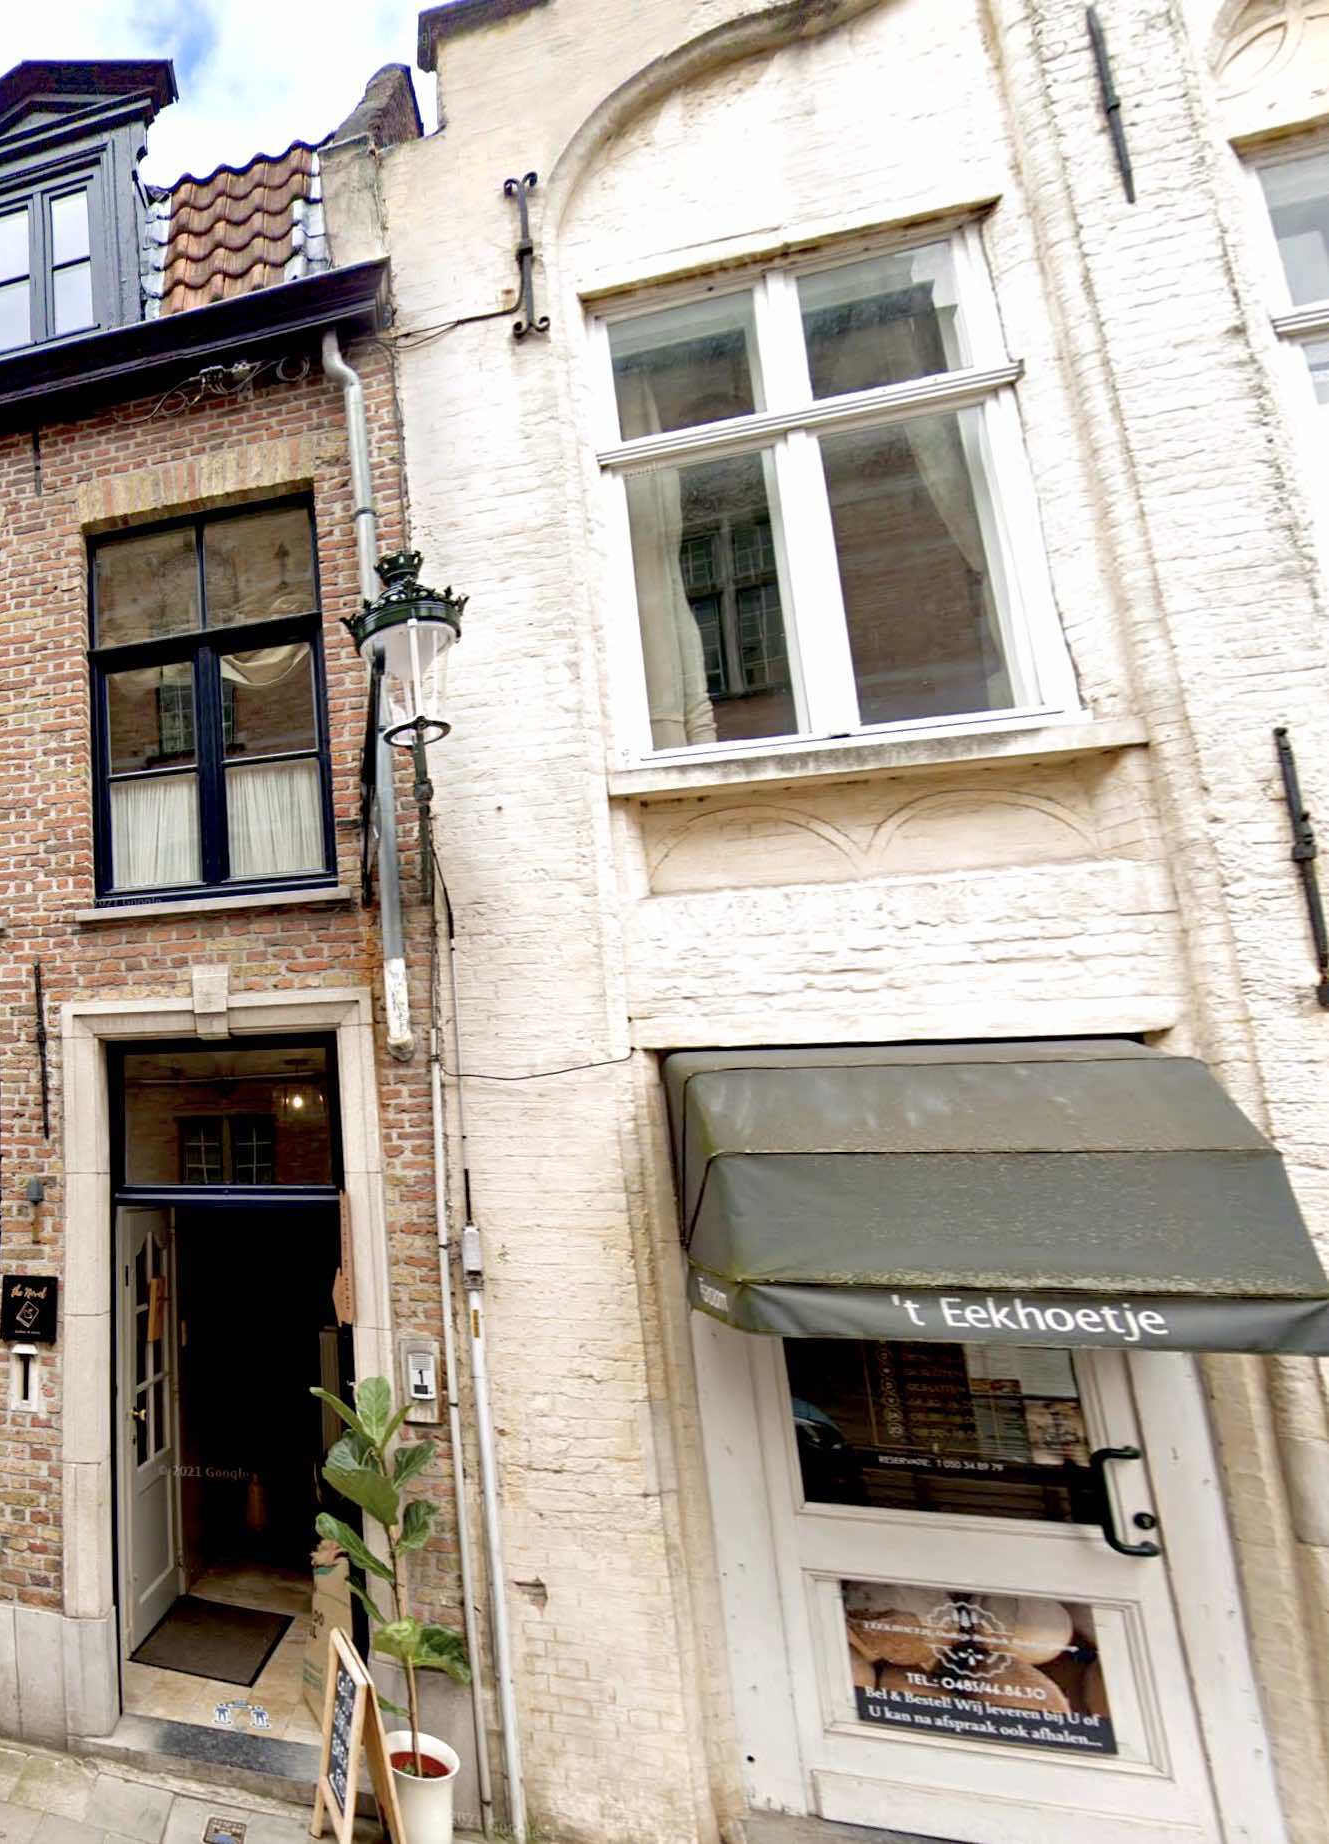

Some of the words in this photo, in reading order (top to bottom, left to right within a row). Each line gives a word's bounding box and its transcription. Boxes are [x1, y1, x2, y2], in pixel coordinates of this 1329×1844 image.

[890, 1294, 926, 1326] 't
[939, 1297, 1169, 1342] Eekhoetje
[865, 1687, 888, 1699] Bel
[890, 1690, 902, 1702] &
[953, 1698, 984, 1716] Wij
[985, 1701, 1041, 1720] leveren
[1082, 1714, 1101, 1727] of
[868, 1705, 881, 1718] U
[884, 1707, 912, 1722] kan
[914, 1714, 932, 1725] na
[934, 1715, 998, 1734] afspraak
[999, 1724, 1030, 1738] ook
